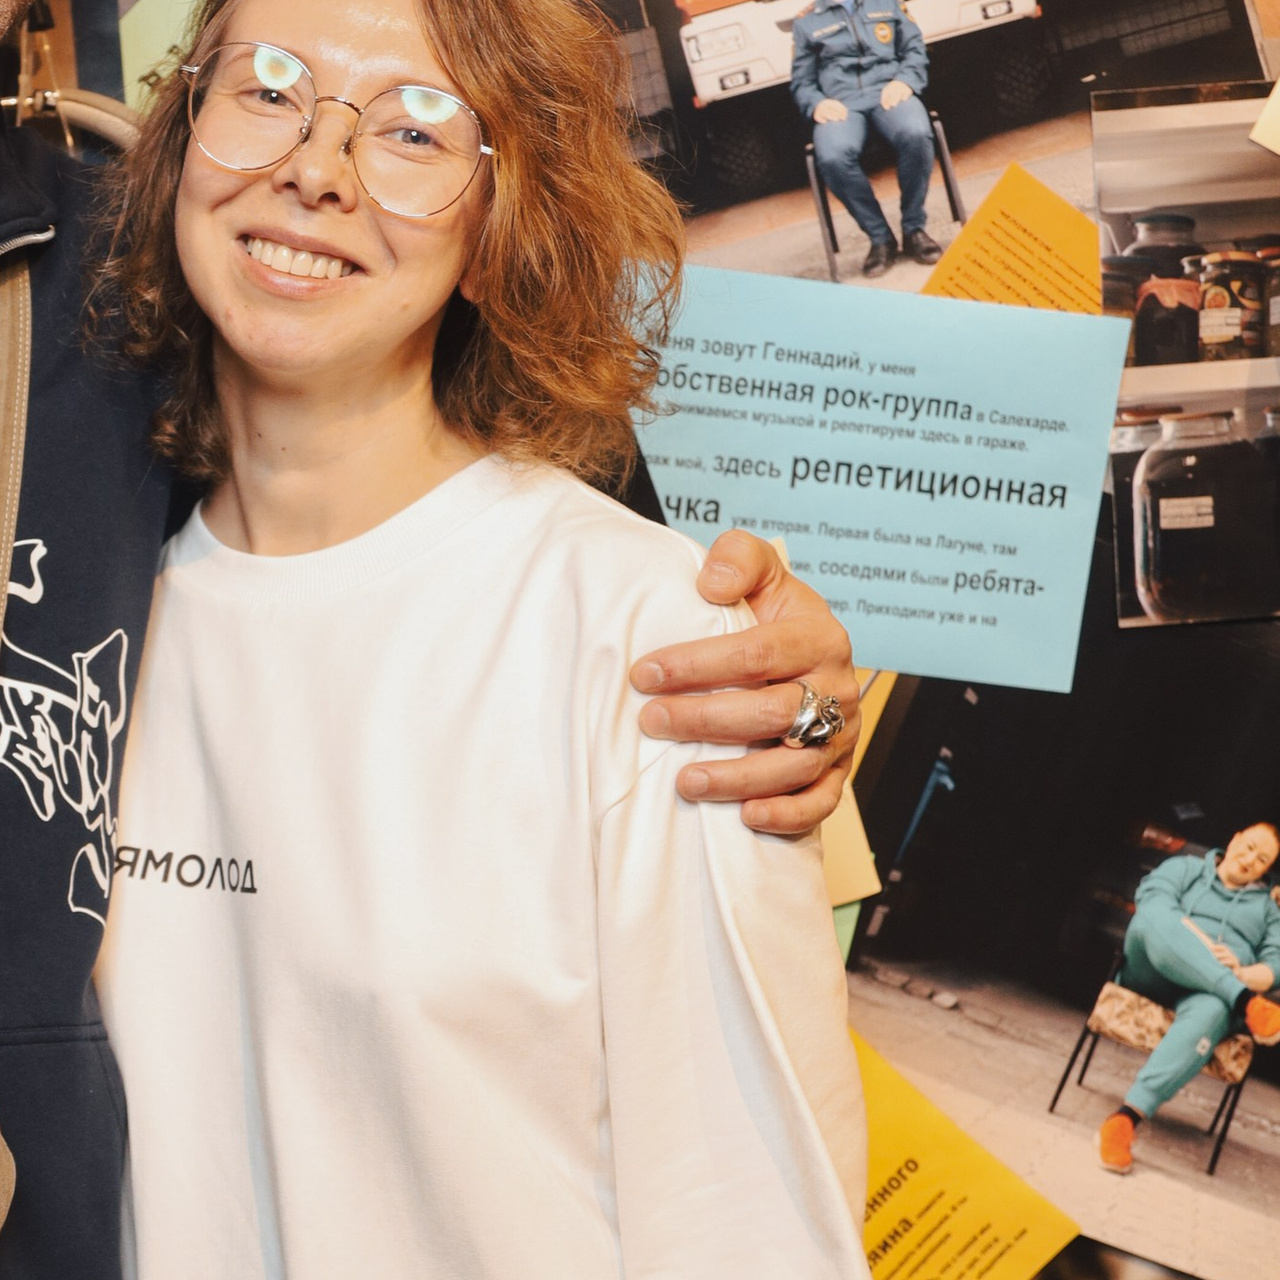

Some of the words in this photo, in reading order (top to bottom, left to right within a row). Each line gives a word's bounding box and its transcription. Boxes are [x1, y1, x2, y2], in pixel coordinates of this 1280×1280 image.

[700, 338, 757, 362] зовут
[761, 340, 860, 370] Геннадий,
[822, 386, 972, 422] рок-группа
[712, 454, 781, 478] здесь
[790, 456, 1067, 509] репетиционная
[952, 568, 1044, 596] ребята-
